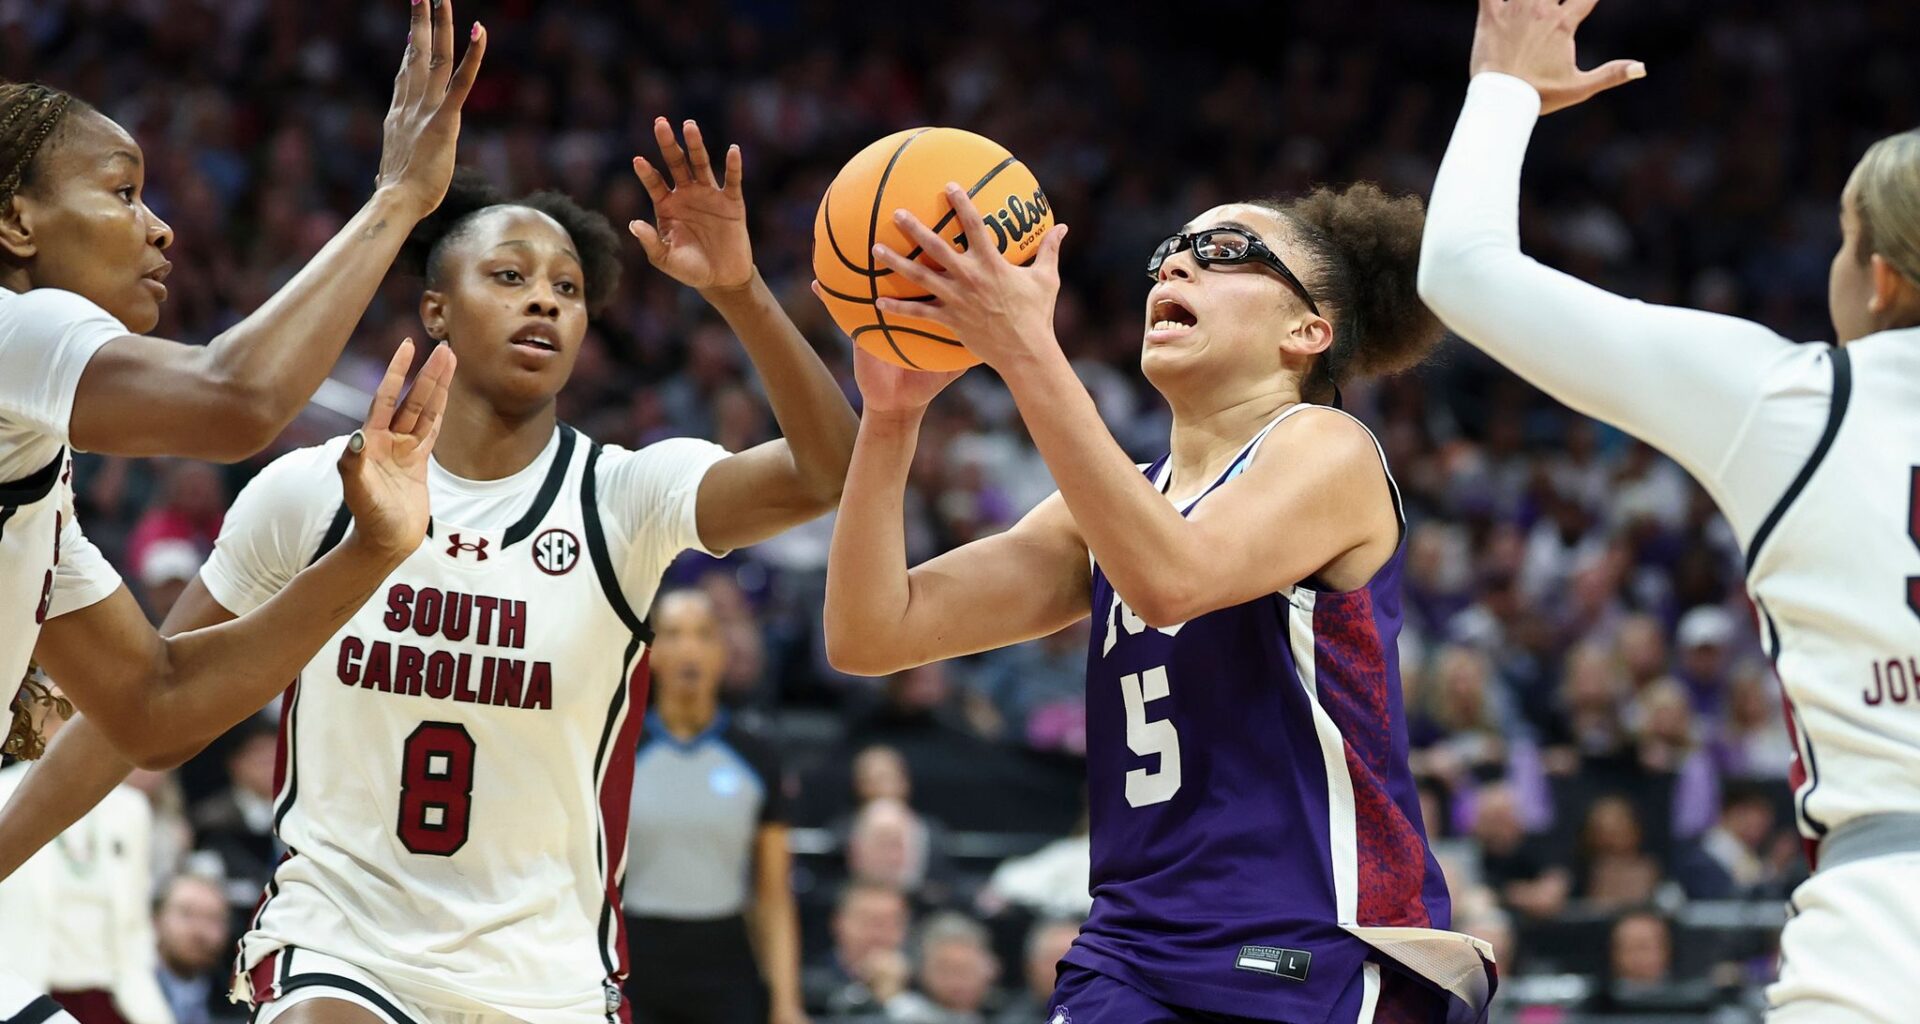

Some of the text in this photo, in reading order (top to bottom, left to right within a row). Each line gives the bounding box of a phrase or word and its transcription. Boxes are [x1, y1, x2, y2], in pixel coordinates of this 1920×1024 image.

[1019, 235, 1035, 251] EVO
[534, 531, 578, 572] SEC
[383, 583, 527, 649] SOUTH
[336, 635, 552, 710] CAROLINA
[1120, 665, 1181, 808] 5
[396, 720, 477, 858] 8
[1289, 956, 1297, 970] L
